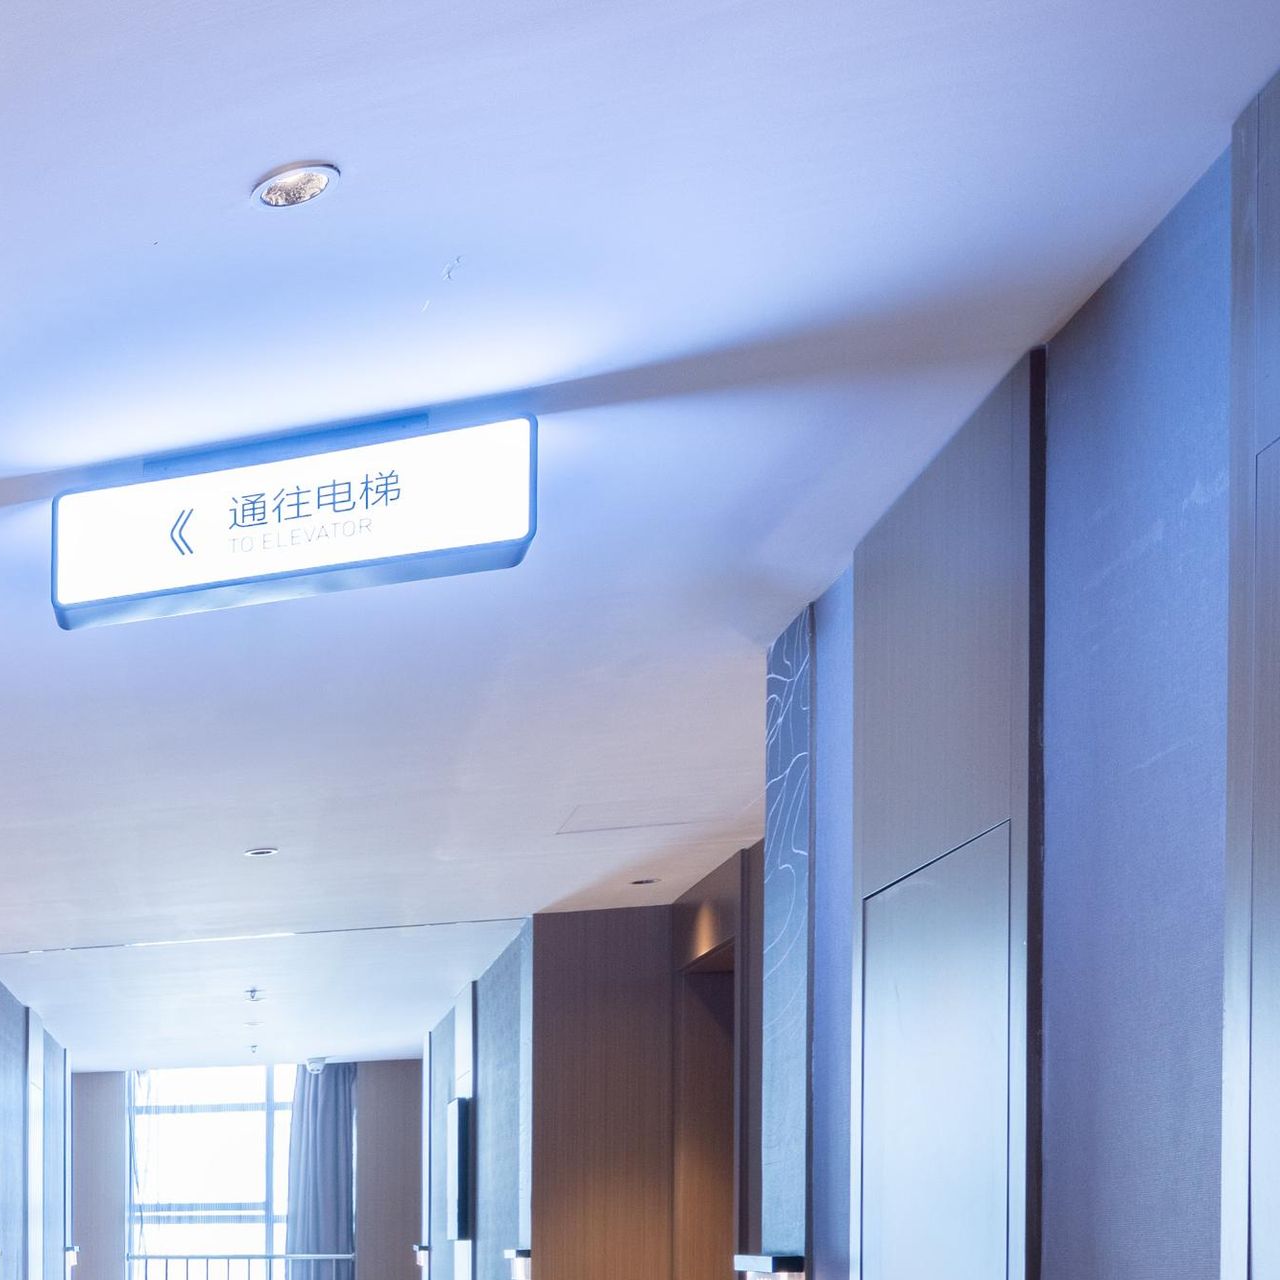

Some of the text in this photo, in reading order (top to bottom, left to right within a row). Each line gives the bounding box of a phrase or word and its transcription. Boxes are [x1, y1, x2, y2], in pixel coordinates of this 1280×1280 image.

[229, 470, 401, 530] 通往电梯
[228, 518, 373, 554] TO ELEVATOR
